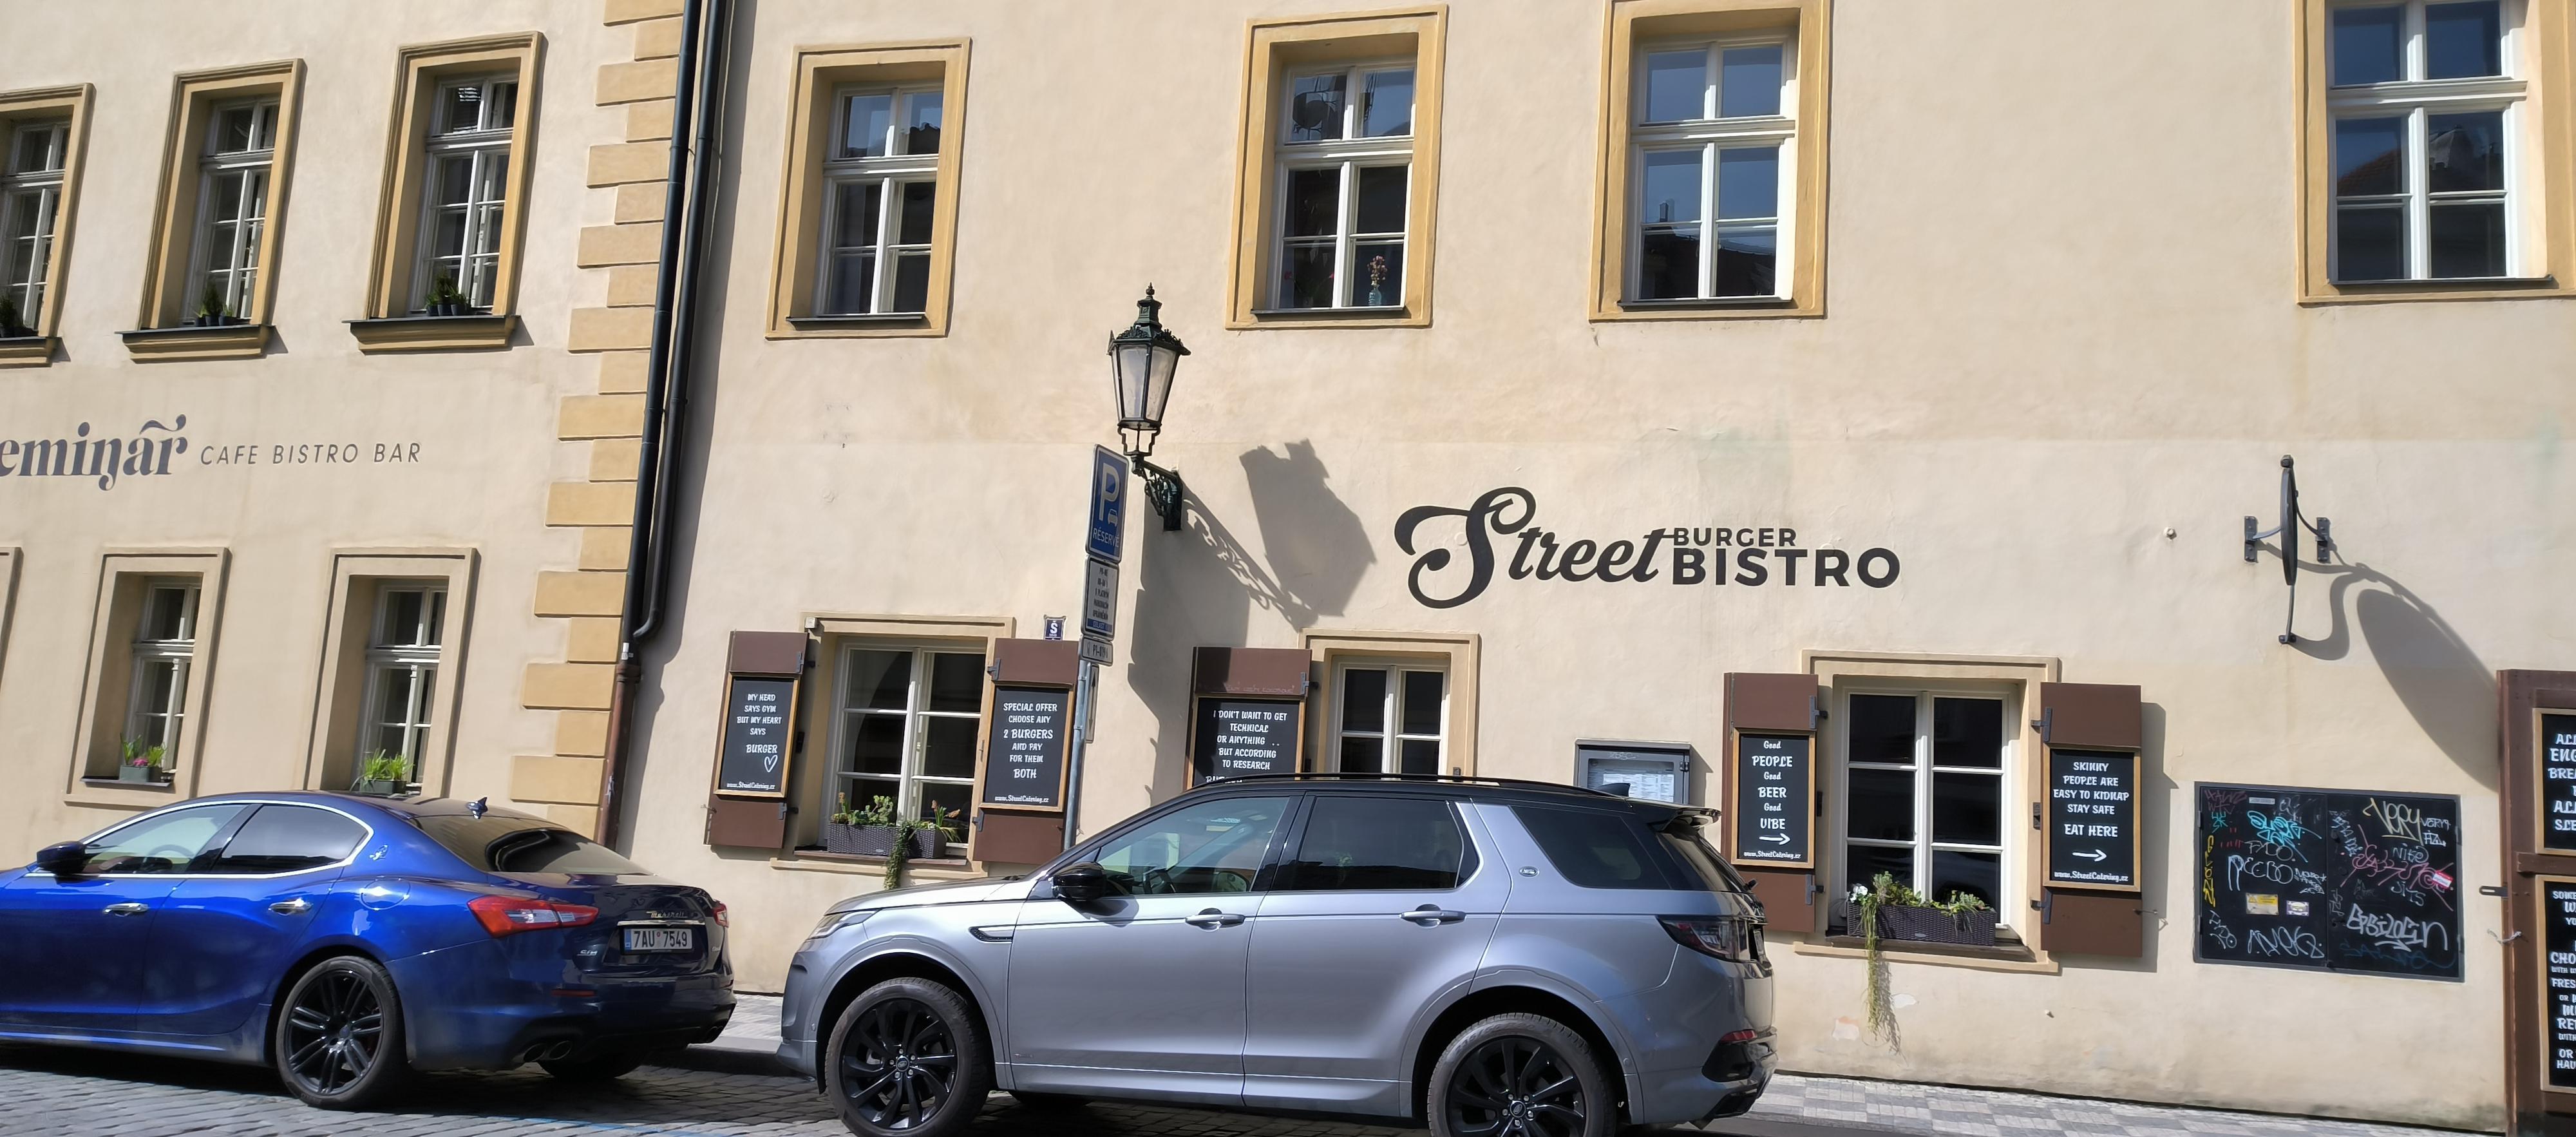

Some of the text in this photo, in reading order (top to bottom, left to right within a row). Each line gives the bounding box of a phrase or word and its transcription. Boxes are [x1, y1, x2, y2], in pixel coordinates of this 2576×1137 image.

[200, 444, 258, 465] CAFE
[272, 443, 359, 464] BISTRO
[374, 442, 422, 463] BAR
[1099, 462, 1121, 522] P
[1674, 527, 1797, 547] BURGER
[1394, 486, 1676, 609] Street
[1672, 548, 1901, 588] BISTRO
[747, 693, 776, 702] MY HEAD
[1003, 702, 1057, 712] SPECIAL OFFER
[1218, 710, 1240, 719] DON'T
[1241, 711, 1262, 720] WANT
[1263, 712, 1272, 720] TO
[1274, 712, 1287, 721] GET
[1229, 723, 1269, 733] TECHNICAL
[1003, 729, 1054, 740] 2 BURGERS
[1217, 735, 1227, 743] OR
[1228, 735, 1265, 745] ANYTHING
[746, 743, 778, 754] BURGER
[1029, 743, 1043, 751] PAY
[1763, 740, 1782, 749] Good
[1218, 747, 1276, 758] BUT ACCORDING
[1009, 754, 1044, 763] FOR THEM
[1751, 755, 1793, 767] PEOPLE
[1222, 760, 1271, 770] TO RESEARCH
[2073, 761, 2109, 772] SKINNY
[1012, 768, 1037, 779] BOTH
[1763, 771, 1782, 780] Good
[2063, 775, 2119, 787] PEOPLE ARE
[1757, 787, 1787, 798] BEER
[2053, 788, 2130, 801] EASY TO KIDNAP
[1763, 803, 1782, 812] Good
[2067, 804, 2115, 815] STAY SAFE
[2063, 823, 2118, 837] EAT HERE
[2054, 870, 2129, 883] www.StreetCatering.cz
[634, 931, 687, 948] 7AU 7549
[2559, 1049, 2574, 1059] OR
